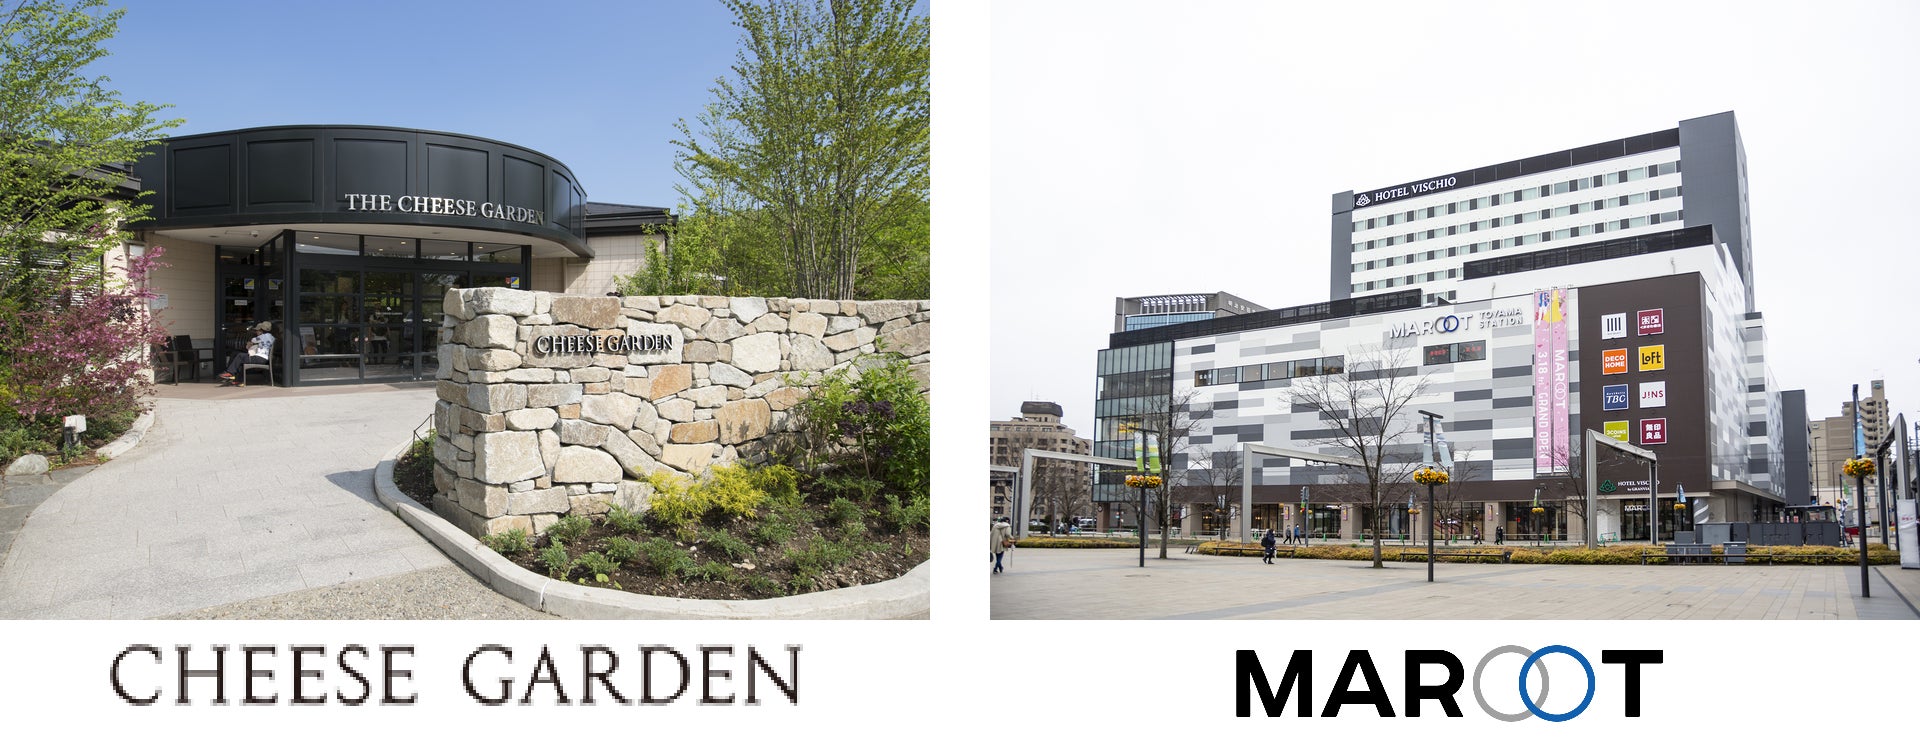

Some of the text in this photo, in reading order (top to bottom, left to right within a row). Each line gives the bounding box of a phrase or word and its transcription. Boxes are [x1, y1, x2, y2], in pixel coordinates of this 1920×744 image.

[1375, 176, 1457, 202] HOTEL VISCHIO
[345, 193, 545, 226] THE CHEESE GARDEN
[1479, 308, 1523, 320] TOYAMA
[1480, 317, 1523, 329] STATION
[1390, 315, 1473, 338] MAROOT
[537, 334, 674, 355] CHEESE GARDEN
[1538, 351, 1548, 374] 3.18
[1605, 354, 1625, 362] DECO
[1605, 361, 1625, 369] HOME
[1554, 349, 1567, 409] MAROOT
[1538, 392, 1548, 428] GRAND
[1605, 394, 1626, 404] TBC
[1538, 431, 1549, 459] OPEN
